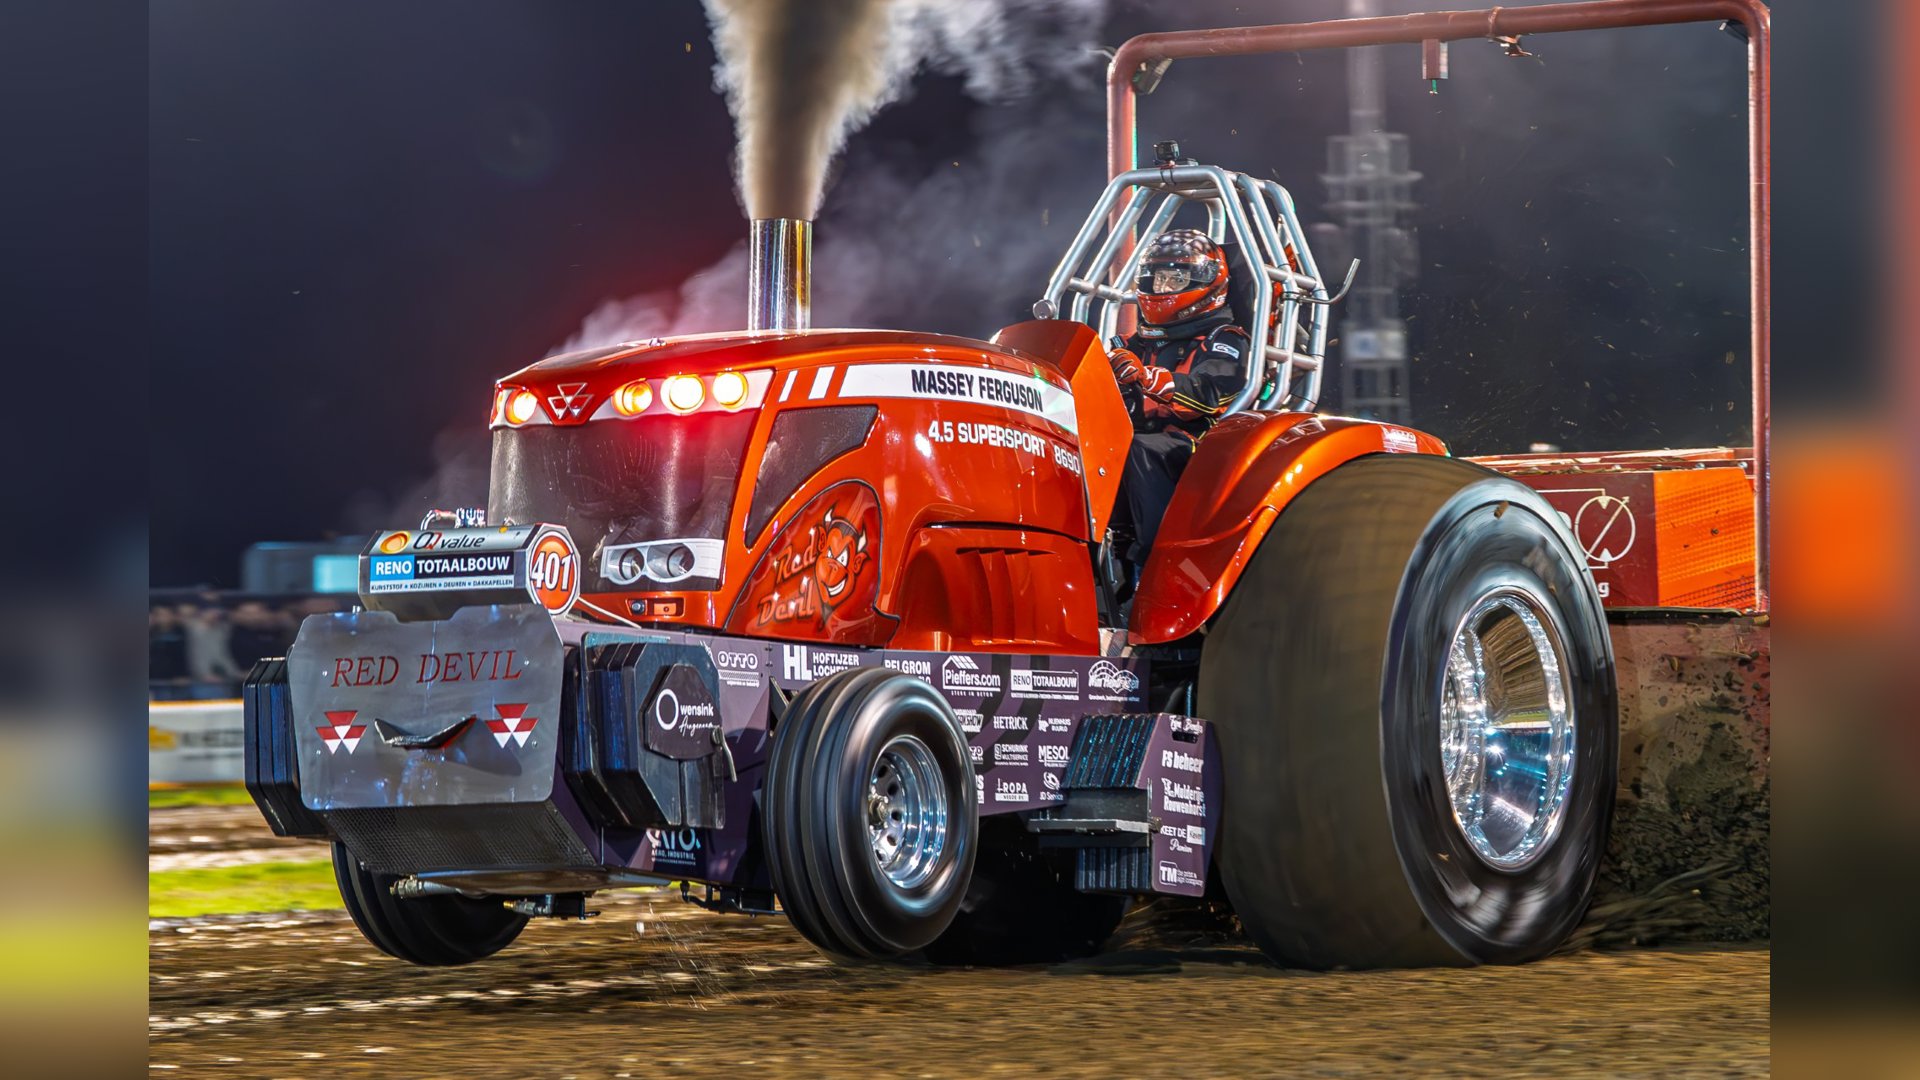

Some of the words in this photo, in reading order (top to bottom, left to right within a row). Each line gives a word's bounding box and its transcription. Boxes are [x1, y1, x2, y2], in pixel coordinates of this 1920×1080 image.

[911, 369, 974, 397] MASSEY
[979, 375, 1044, 412] FERGUSON
[928, 420, 954, 442] 4.5
[958, 422, 1046, 458] SUPERSPORT
[1054, 444, 1081, 475] 8690
[375, 560, 412, 576] RENO
[416, 556, 510, 575] TOTAALBOUW
[530, 551, 574, 591] 401
[371, 583, 403, 591] KUNSTSTOF
[409, 582, 437, 590] KOZIJNEN
[443, 580, 467, 588] DEUREN
[472, 578, 514, 587] DAKKAPELLEN
[331, 655, 400, 688] RED
[416, 650, 523, 684] DEVIL
[717, 650, 758, 670] OTTO
[783, 645, 812, 680] HL
[812, 652, 860, 667] HOFTIJZER
[945, 669, 1001, 687] Pieffers.com
[1013, 674, 1031, 685] RENO
[1032, 675, 1077, 688] TOTAALBOUW
[993, 716, 1028, 730] HETRICK
[1160, 866, 1177, 883] TM
